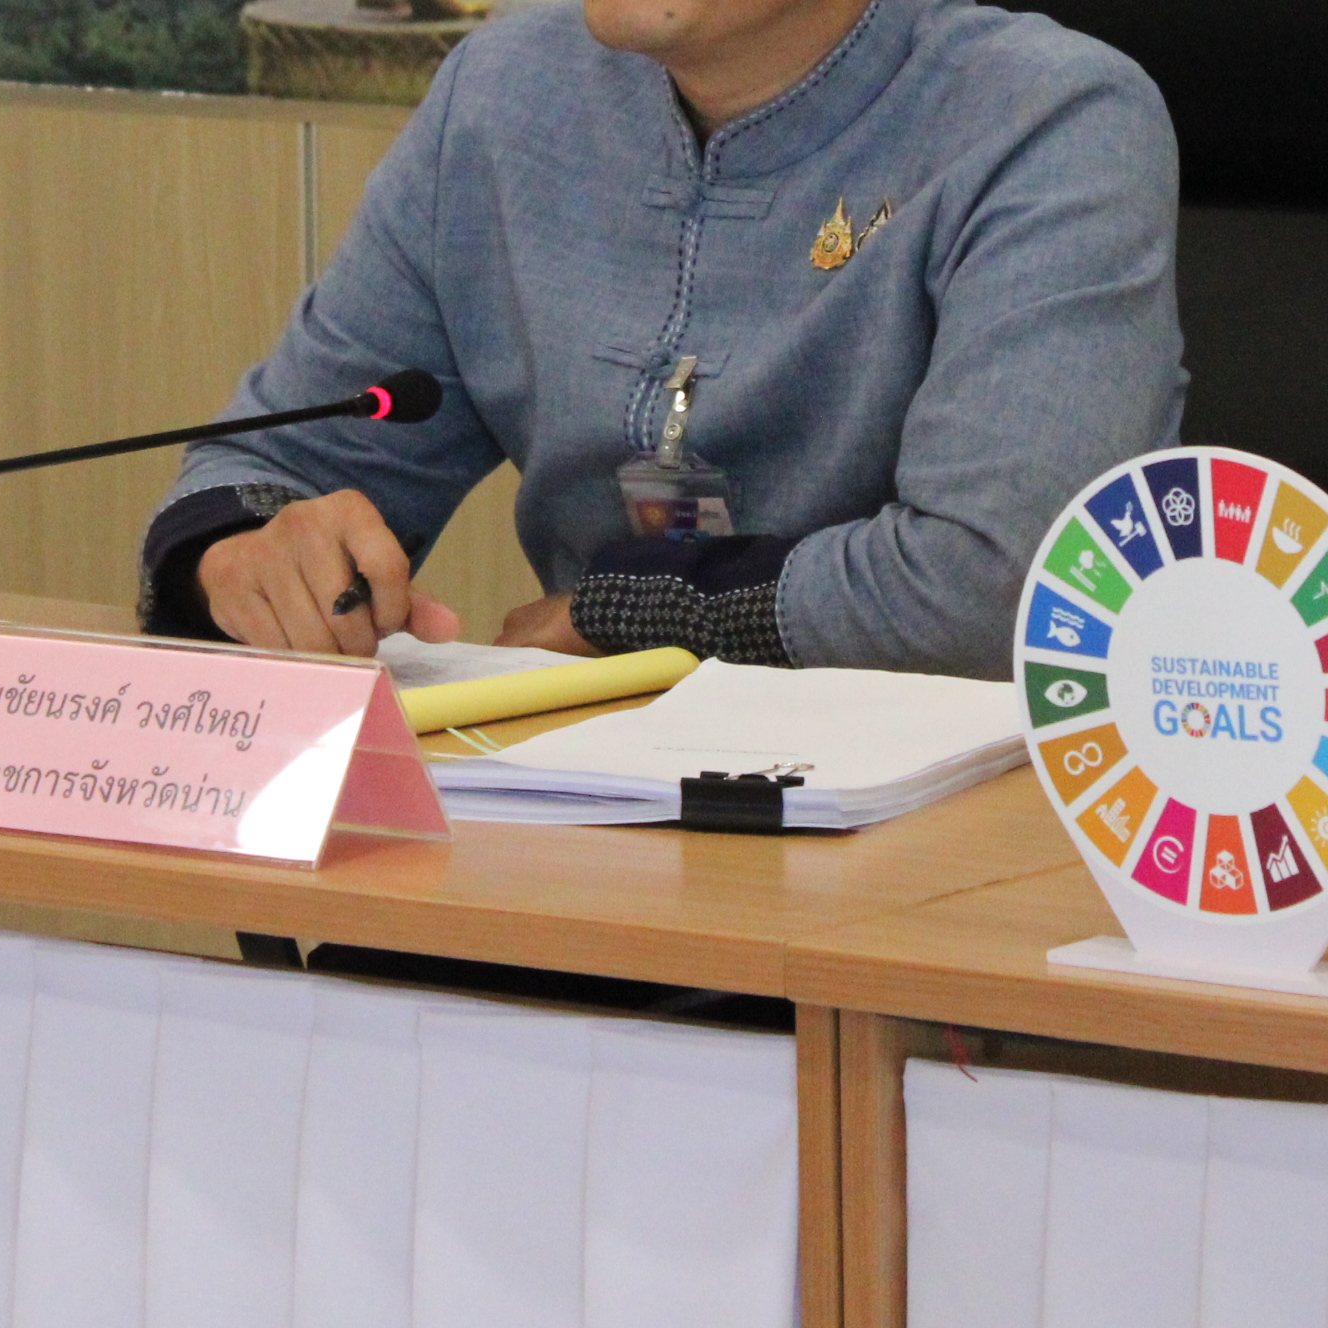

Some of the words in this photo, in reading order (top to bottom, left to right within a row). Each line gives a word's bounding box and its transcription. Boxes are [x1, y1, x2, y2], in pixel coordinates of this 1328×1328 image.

[1151, 656, 1280, 680] SUSTAINABLE
[1151, 678, 1280, 701] DEVELOPMENT
[135, 690, 266, 753] วงศ์ใหญ่
[1153, 699, 1284, 743] GOALS
